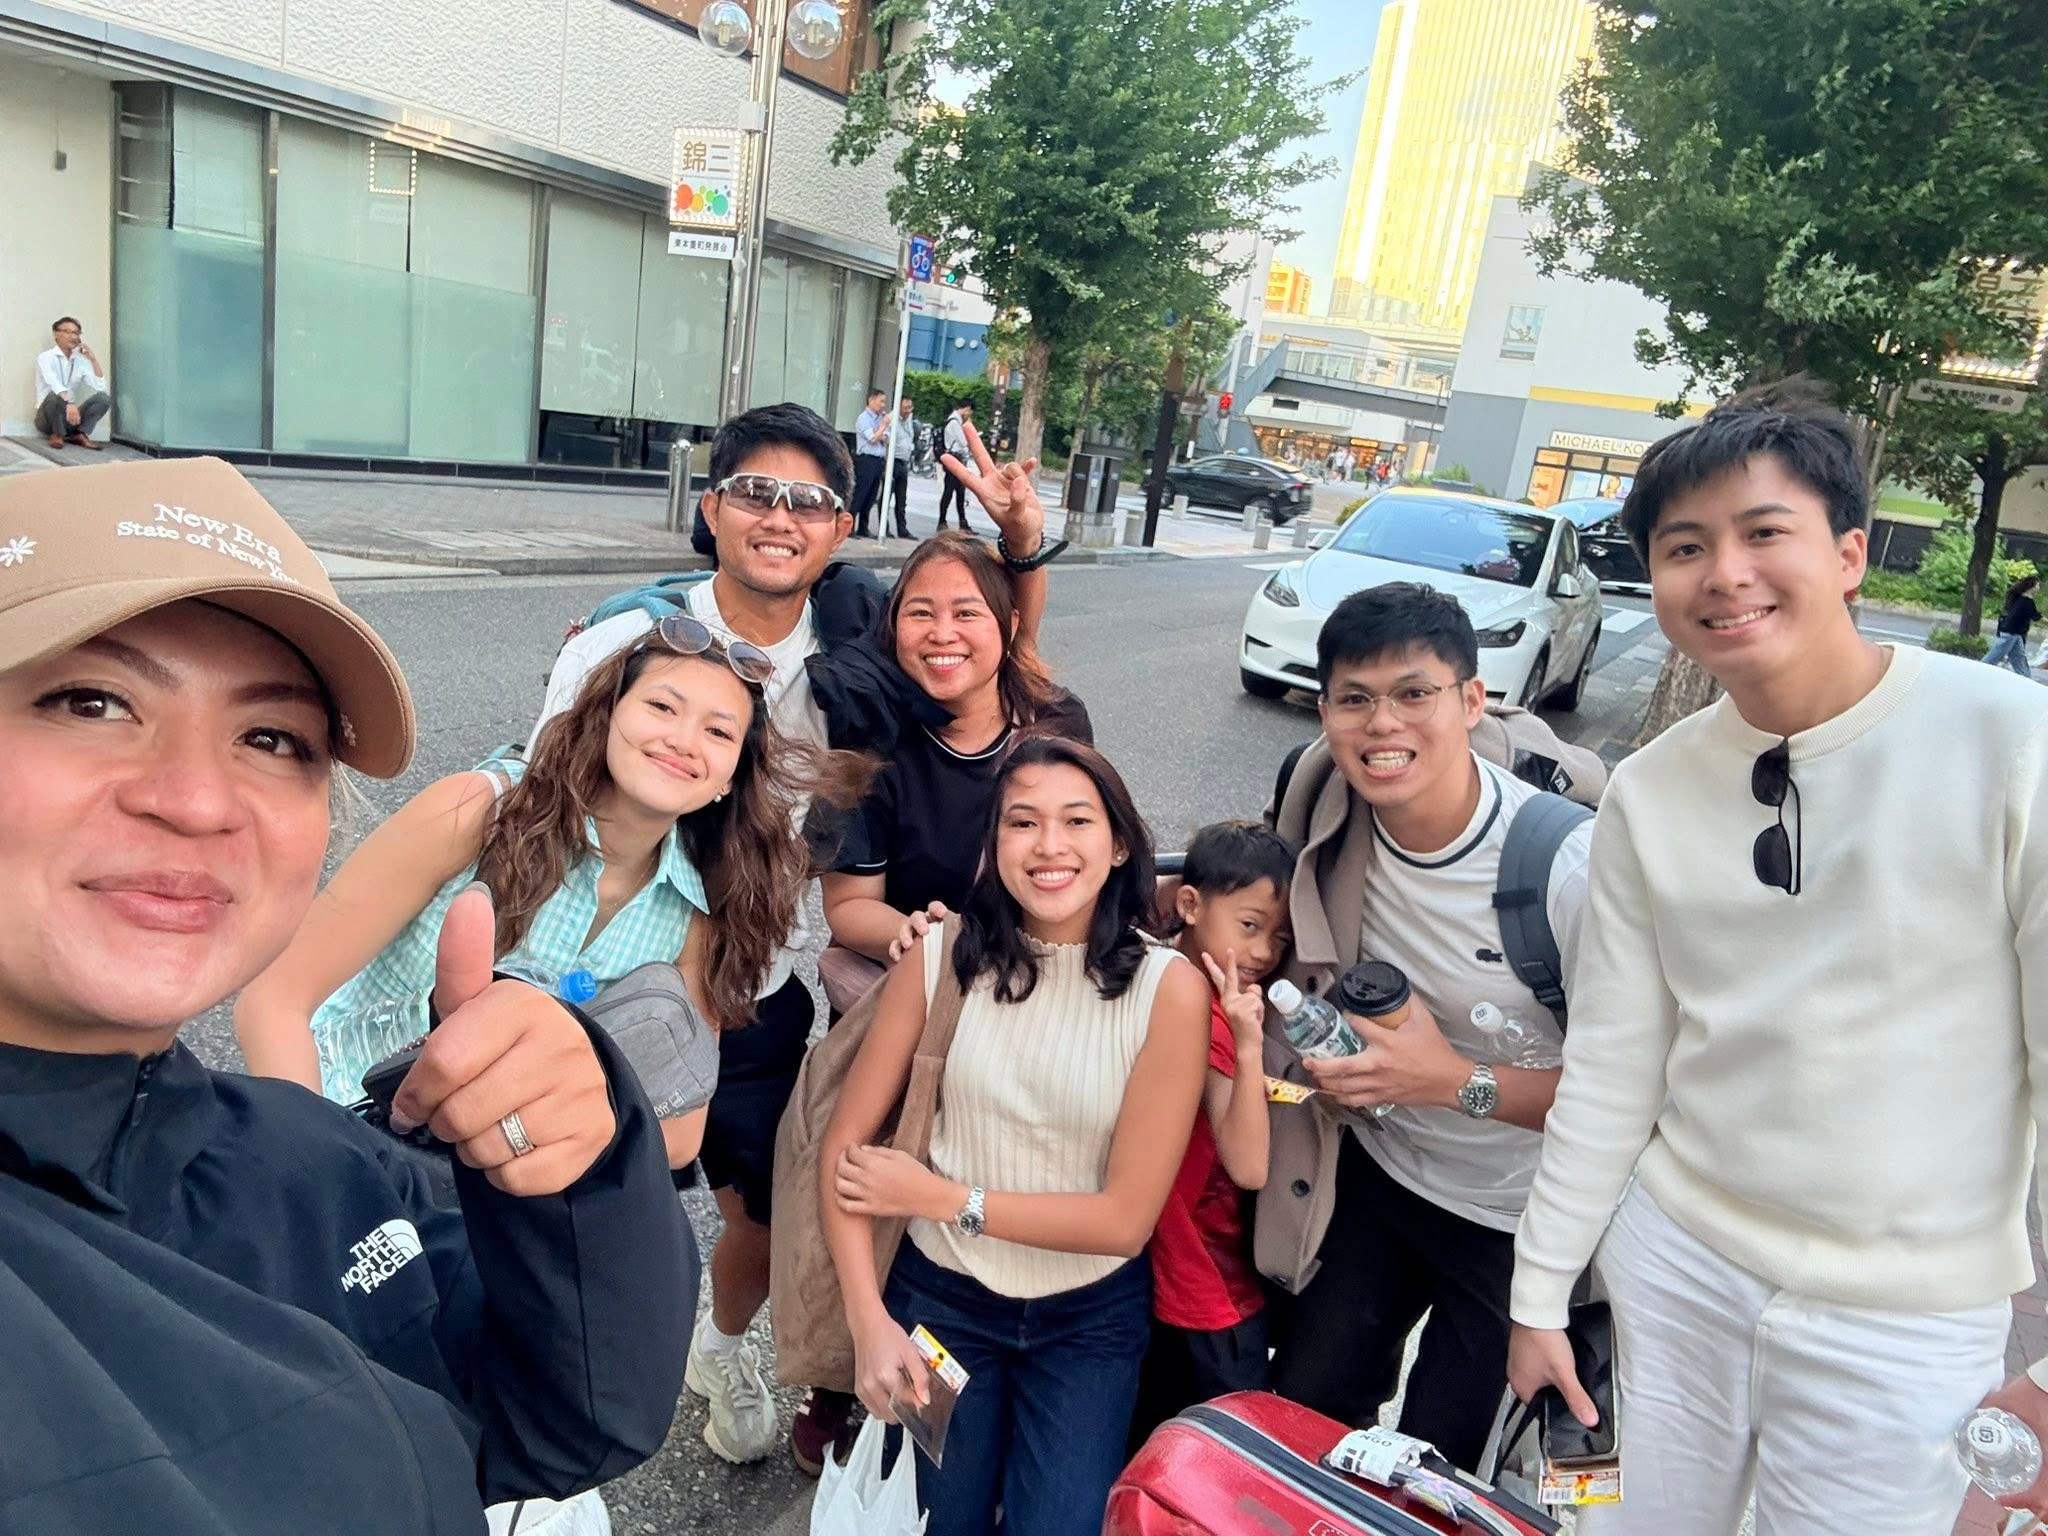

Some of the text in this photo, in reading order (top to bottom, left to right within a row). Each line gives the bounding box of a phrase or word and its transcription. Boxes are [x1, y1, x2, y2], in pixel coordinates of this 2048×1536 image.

[682, 141, 730, 173] 錦三
[1554, 435, 1651, 455] MICHAEL KO
[117, 520, 180, 540] State
[186, 533, 213, 549] of
[216, 538, 265, 570] New
[154, 503, 282, 564] New Era
[349, 1228, 388, 1260] THE
[341, 1239, 398, 1292] NORTH
[360, 1250, 408, 1294] FACE
[1360, 1433, 1392, 1448] NGO
